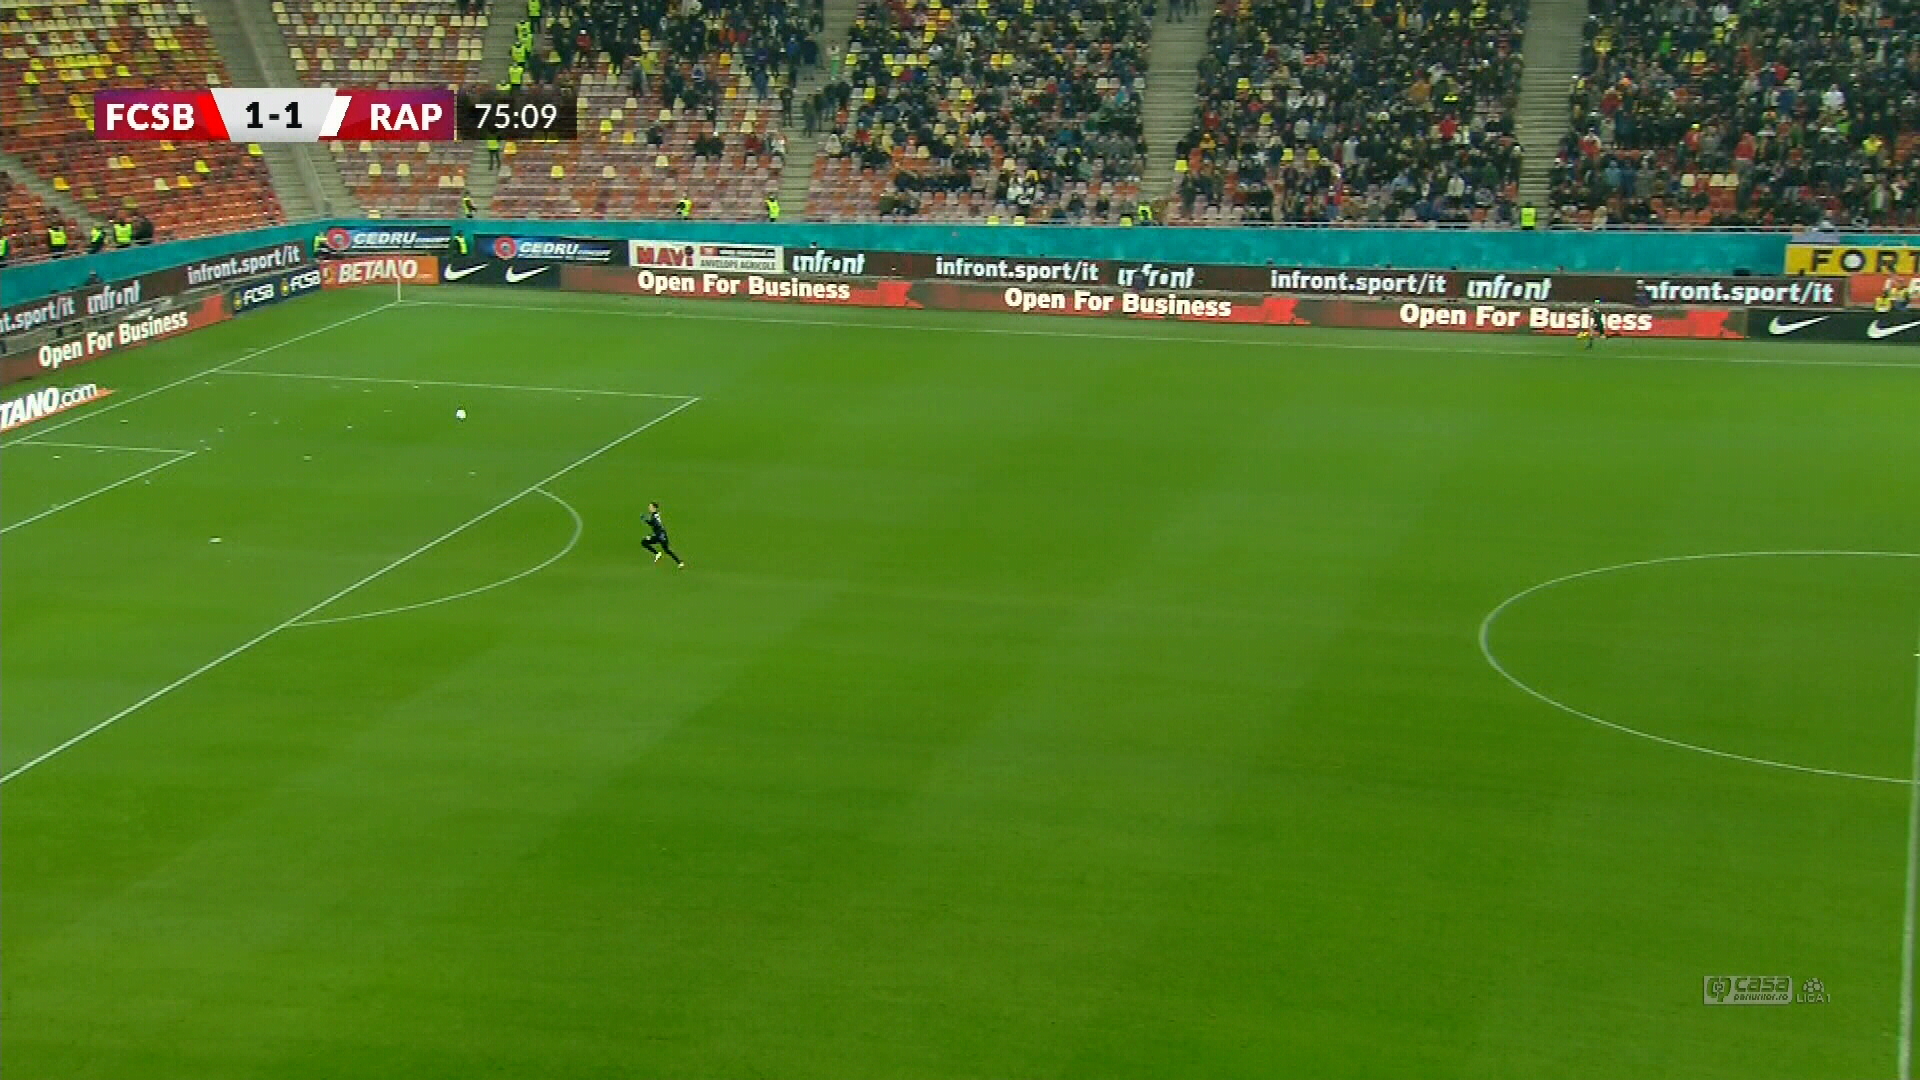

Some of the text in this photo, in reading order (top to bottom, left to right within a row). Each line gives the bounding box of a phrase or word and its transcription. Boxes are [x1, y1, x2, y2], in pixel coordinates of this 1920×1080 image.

[353, 231, 417, 245] CEDRU
[519, 242, 580, 255] CEDRU
[187, 244, 301, 285] infront.sport/it
[338, 258, 418, 283] BETANO
[792, 250, 866, 274] infront
[935, 256, 1099, 283] infront.sport/it
[290, 269, 321, 293] FCSB
[637, 270, 851, 300] Open For Business
[1270, 269, 1446, 295] infront.sport/it
[1643, 280, 1834, 304] nfront.sport/it
[242, 283, 275, 306] FCSB
[1003, 287, 1232, 317] Open For Business
[1399, 303, 1467, 328] Open
[1475, 305, 1520, 328] For
[38, 311, 189, 368] Open For Business
